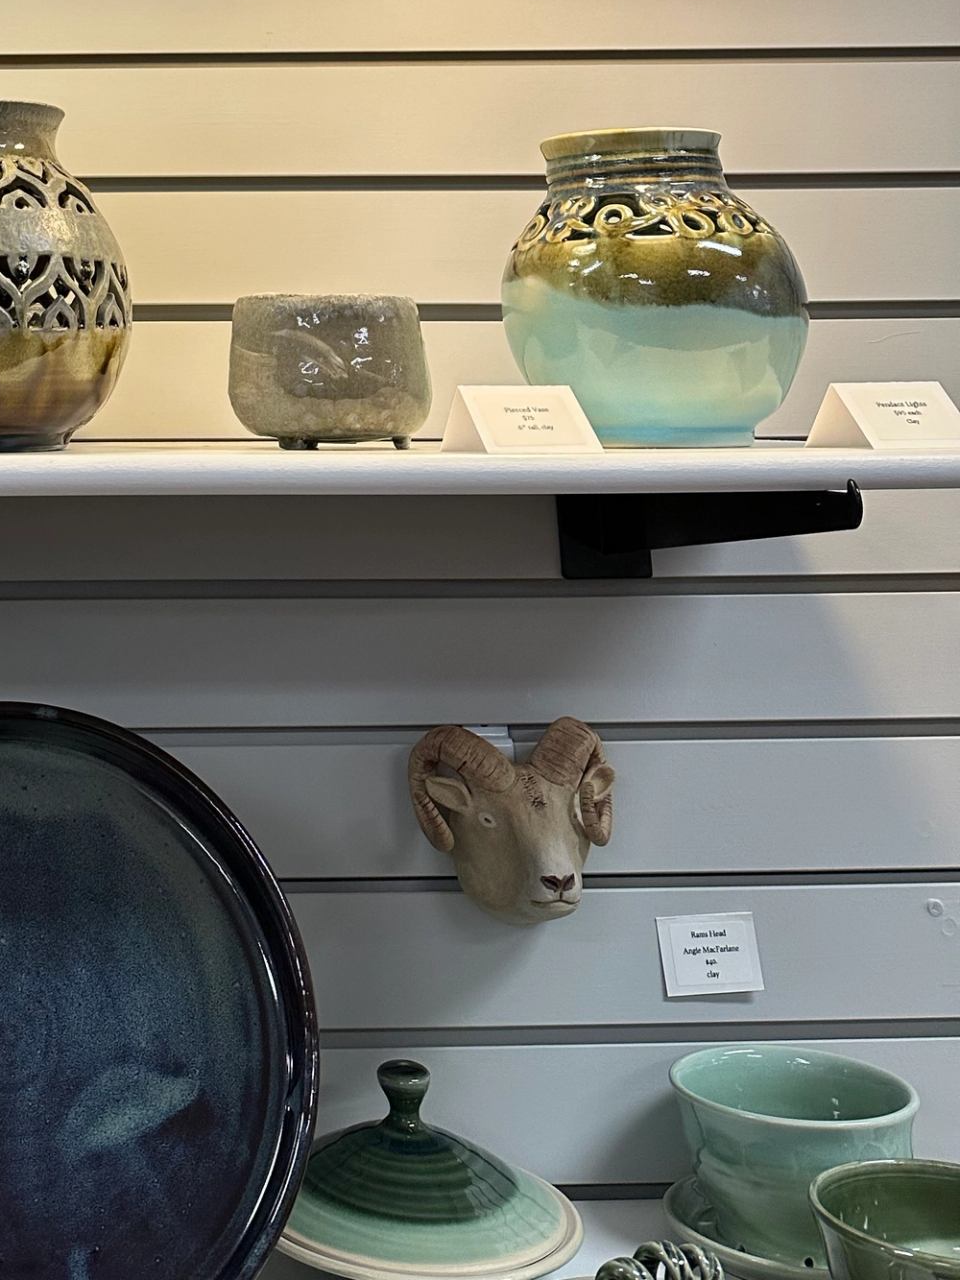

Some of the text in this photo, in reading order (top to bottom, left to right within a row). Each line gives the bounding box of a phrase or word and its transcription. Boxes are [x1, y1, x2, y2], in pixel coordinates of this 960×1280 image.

[905, 401, 928, 409] Lights
[690, 929, 727, 939] Rams Head
[683, 945, 740, 956] Angie MacFarlane
[706, 970, 720, 979] clay
